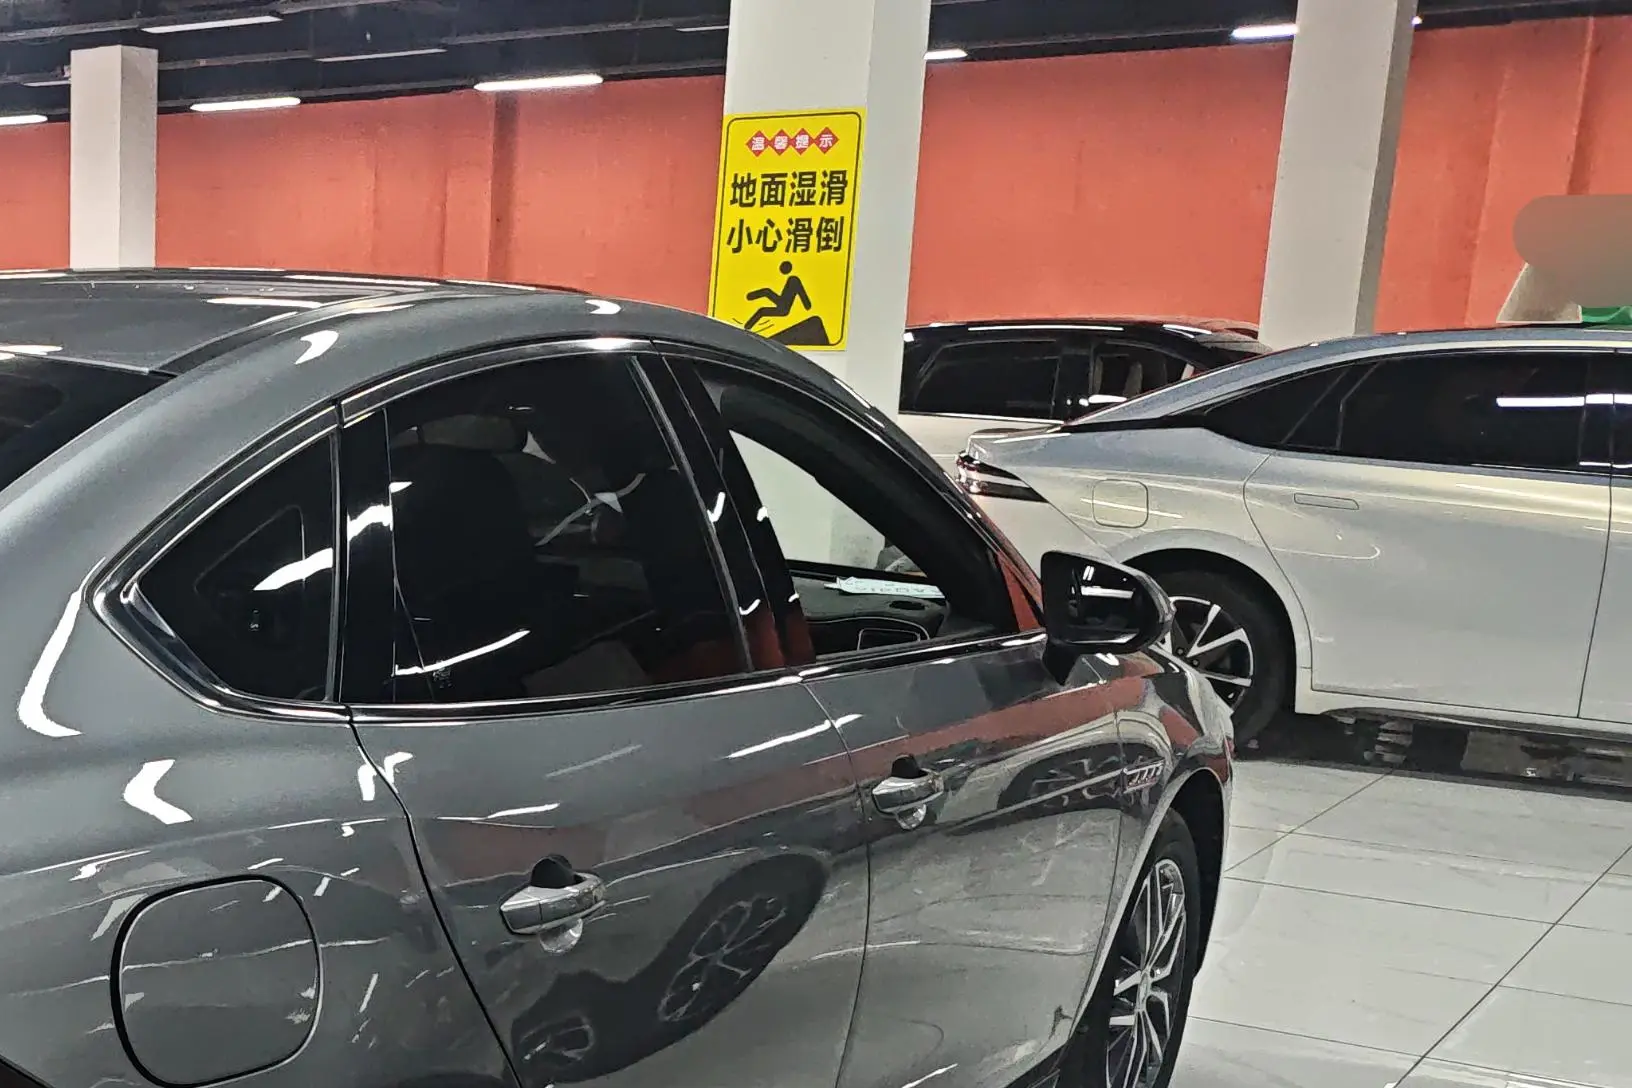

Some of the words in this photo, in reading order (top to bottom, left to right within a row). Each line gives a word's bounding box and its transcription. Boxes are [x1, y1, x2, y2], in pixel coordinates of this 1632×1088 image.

[750, 133, 834, 151] 温馨提示
[729, 170, 848, 209] 地面湿滑
[726, 216, 845, 254] 小心滑倒
